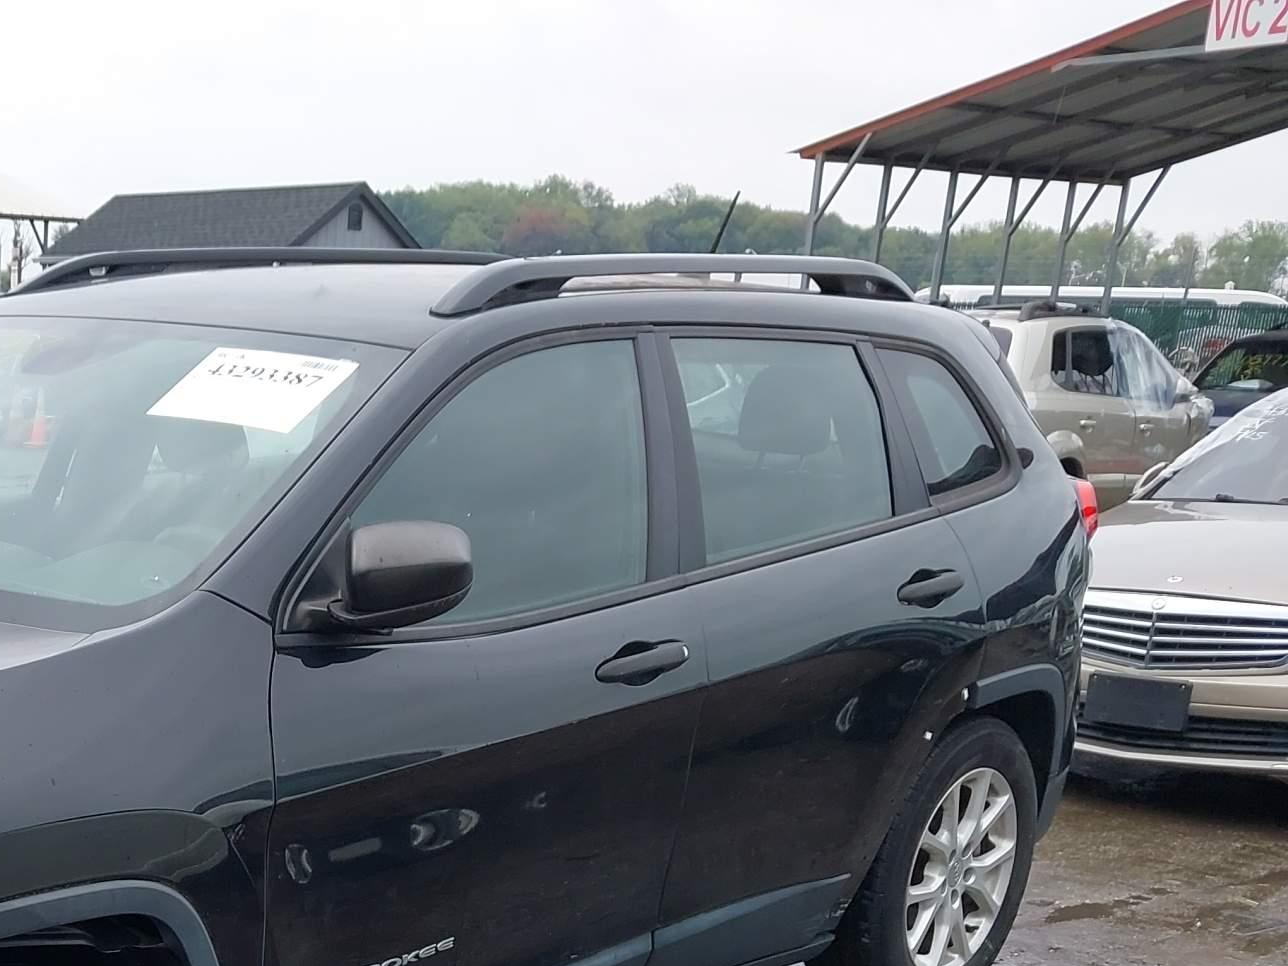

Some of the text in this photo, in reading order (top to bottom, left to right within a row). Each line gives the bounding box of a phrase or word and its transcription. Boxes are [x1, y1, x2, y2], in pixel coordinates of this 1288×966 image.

[1215, 0, 1288, 41] VIC 2
[207, 362, 324, 388] 43293387
